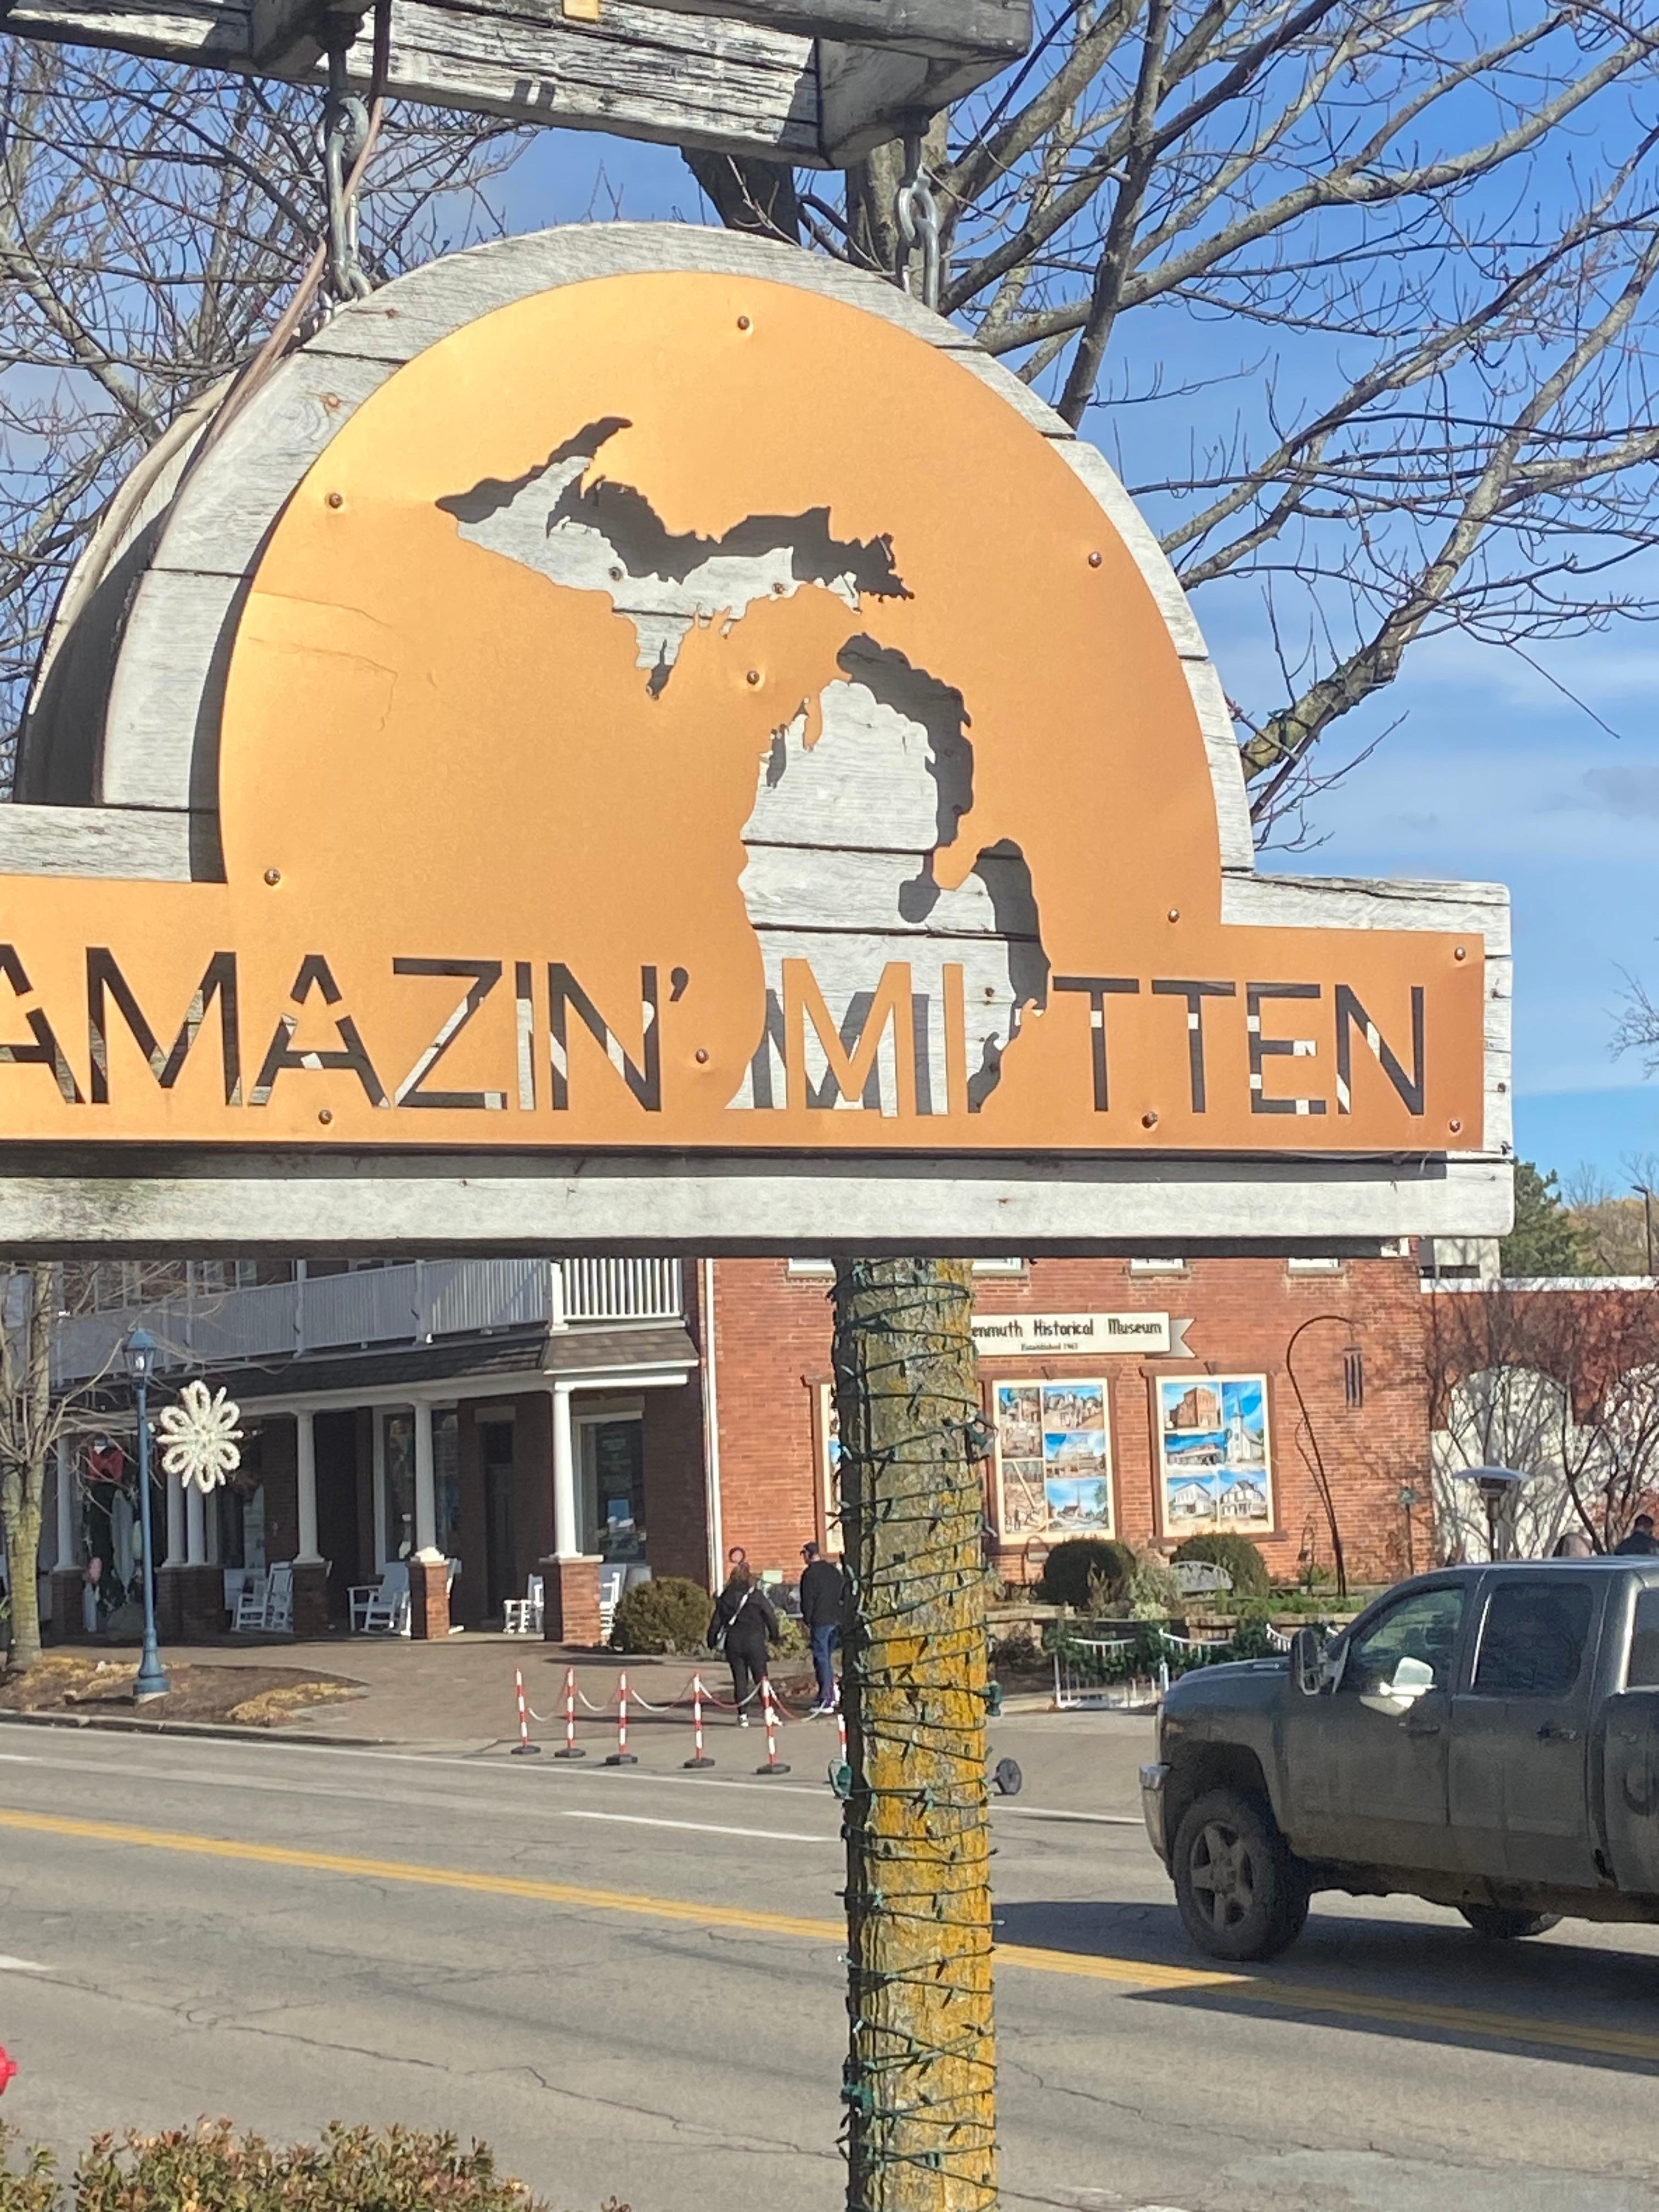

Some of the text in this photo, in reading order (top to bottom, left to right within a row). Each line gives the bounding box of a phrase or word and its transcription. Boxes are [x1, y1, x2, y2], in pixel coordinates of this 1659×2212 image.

[782, 958, 1425, 1118] MITTEN
[1034, 1318, 1093, 1336] Historical
[1108, 1318, 1162, 1335] Museum
